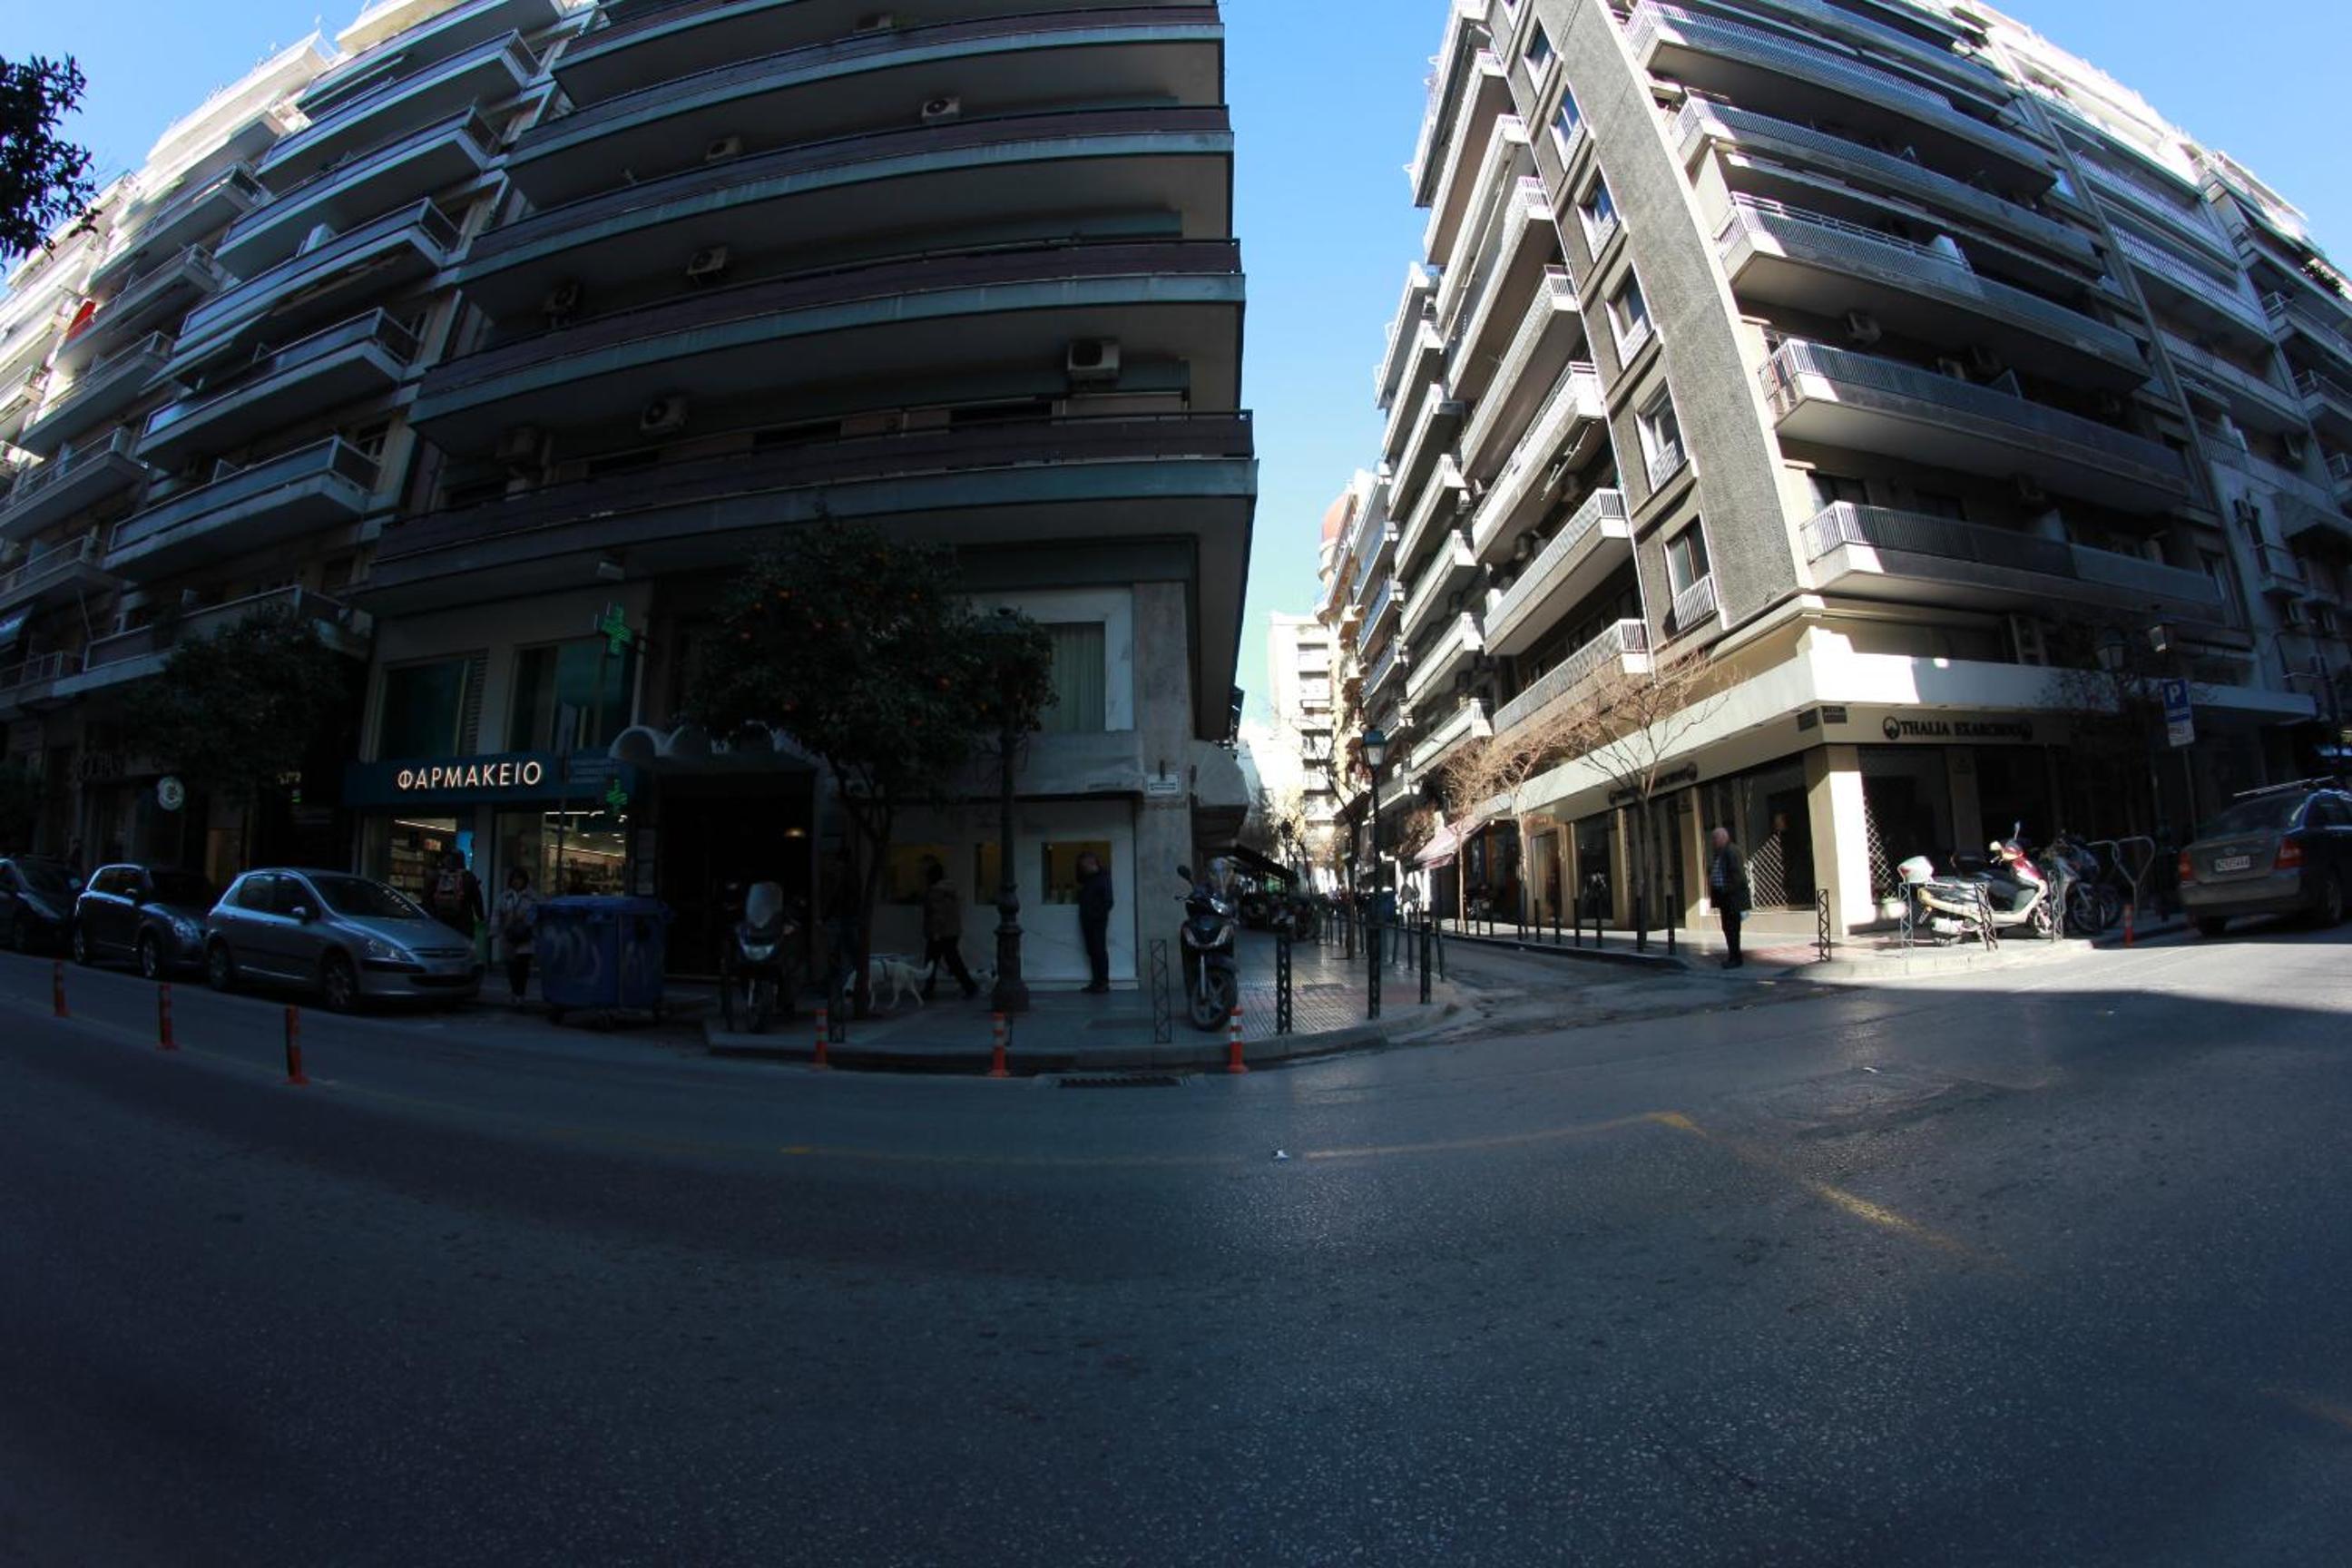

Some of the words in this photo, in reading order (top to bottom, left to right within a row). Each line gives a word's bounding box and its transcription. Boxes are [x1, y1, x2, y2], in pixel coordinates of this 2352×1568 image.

[2168, 683, 2181, 703] P
[1900, 720, 1950, 736] THALIA
[397, 761, 542, 789] ΦΑΡΜΑΚΕΙΟ
